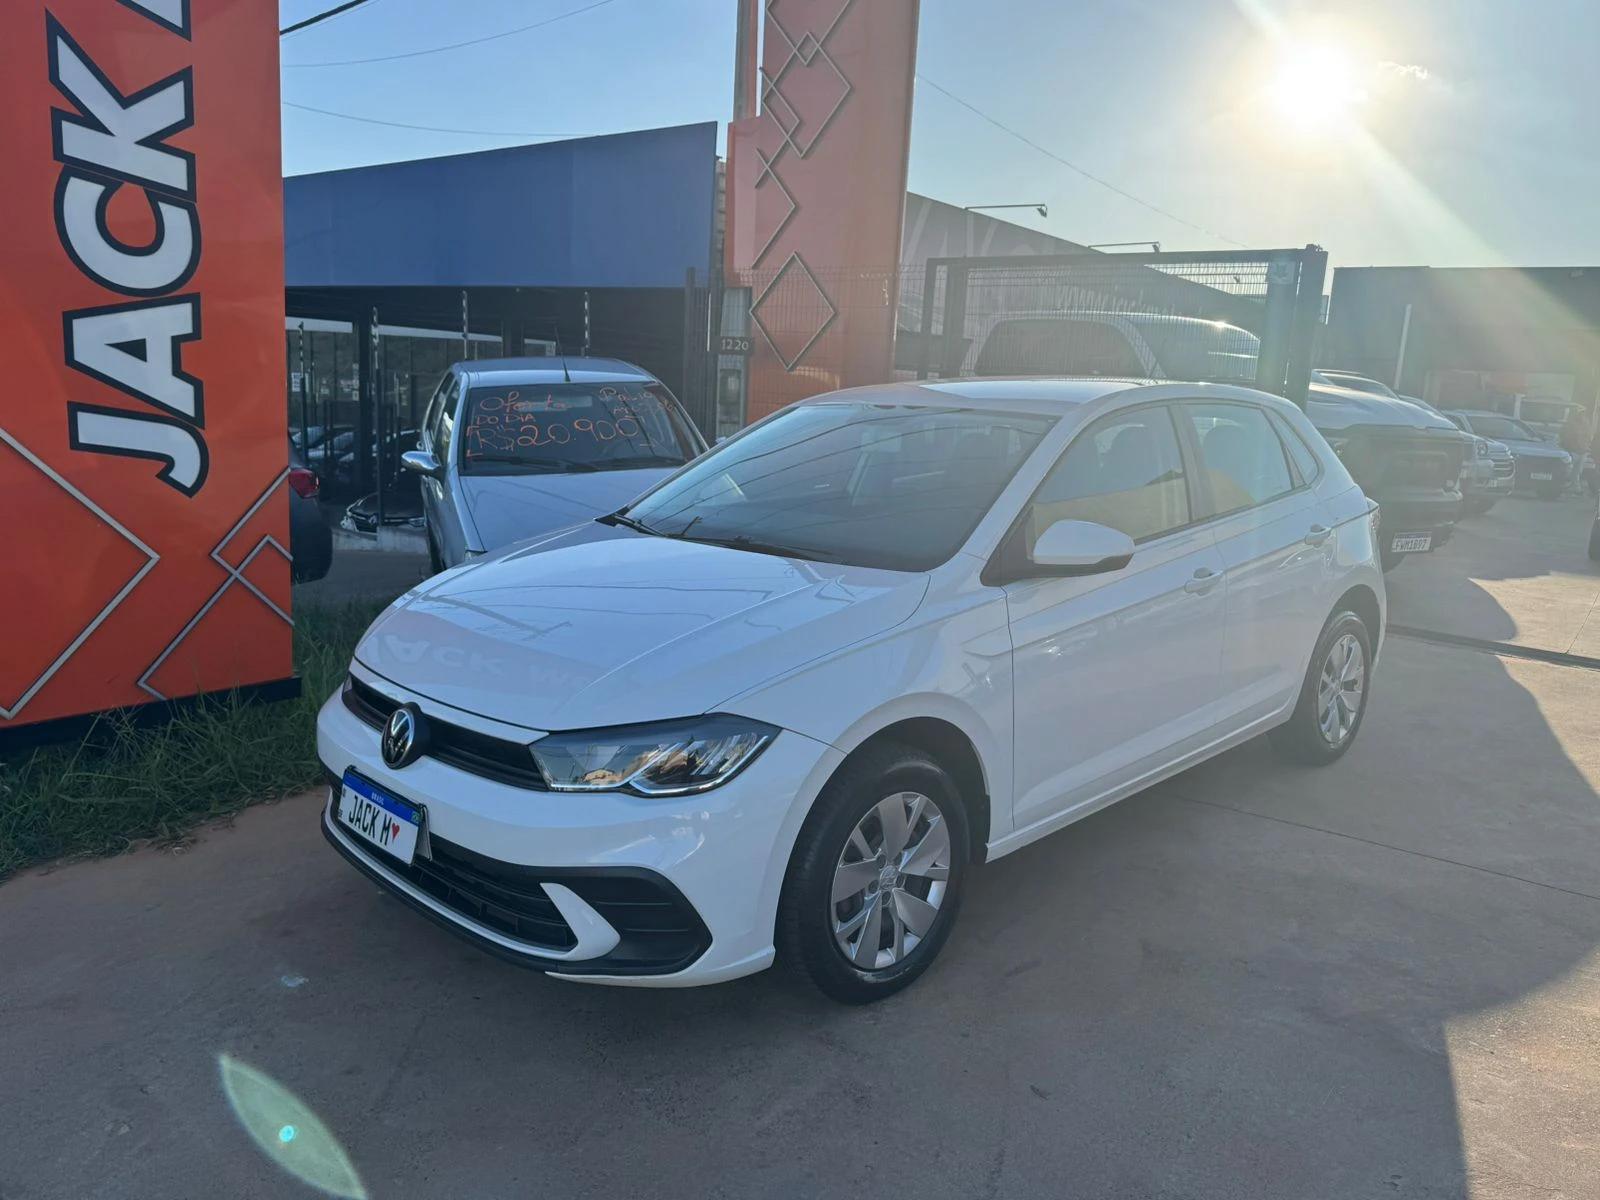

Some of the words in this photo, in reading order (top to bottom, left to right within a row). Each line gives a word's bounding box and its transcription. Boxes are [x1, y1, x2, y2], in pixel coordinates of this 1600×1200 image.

[45, 7, 209, 498] JACK
[721, 338, 750, 351] 1220
[476, 414, 499, 425] DO
[504, 413, 536, 424] DIA
[348, 795, 380, 839] JACK
[379, 813, 393, 846] M
